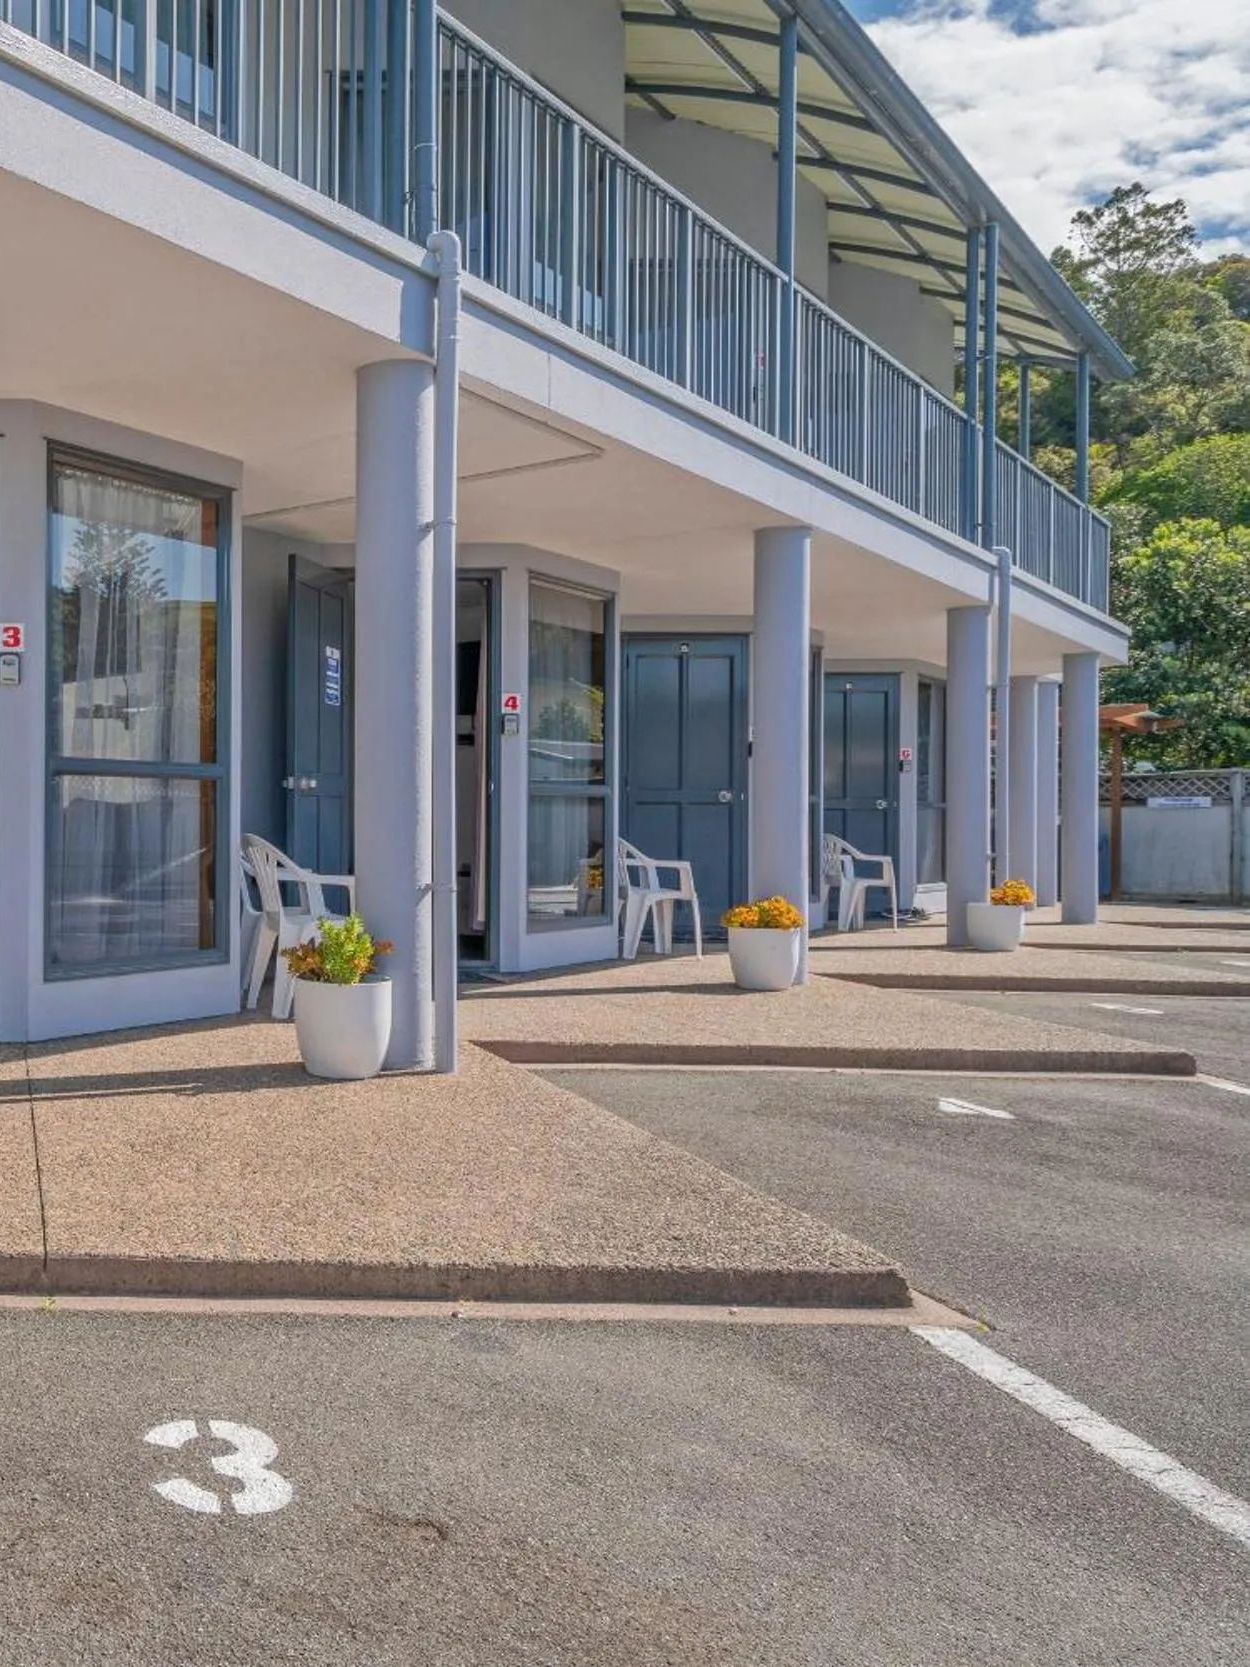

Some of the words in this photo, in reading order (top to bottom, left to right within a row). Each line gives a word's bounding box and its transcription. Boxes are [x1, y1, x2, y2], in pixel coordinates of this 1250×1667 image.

[2, 626, 21, 648] 3
[504, 696, 519, 711] 4
[143, 1419, 294, 1515] 3
